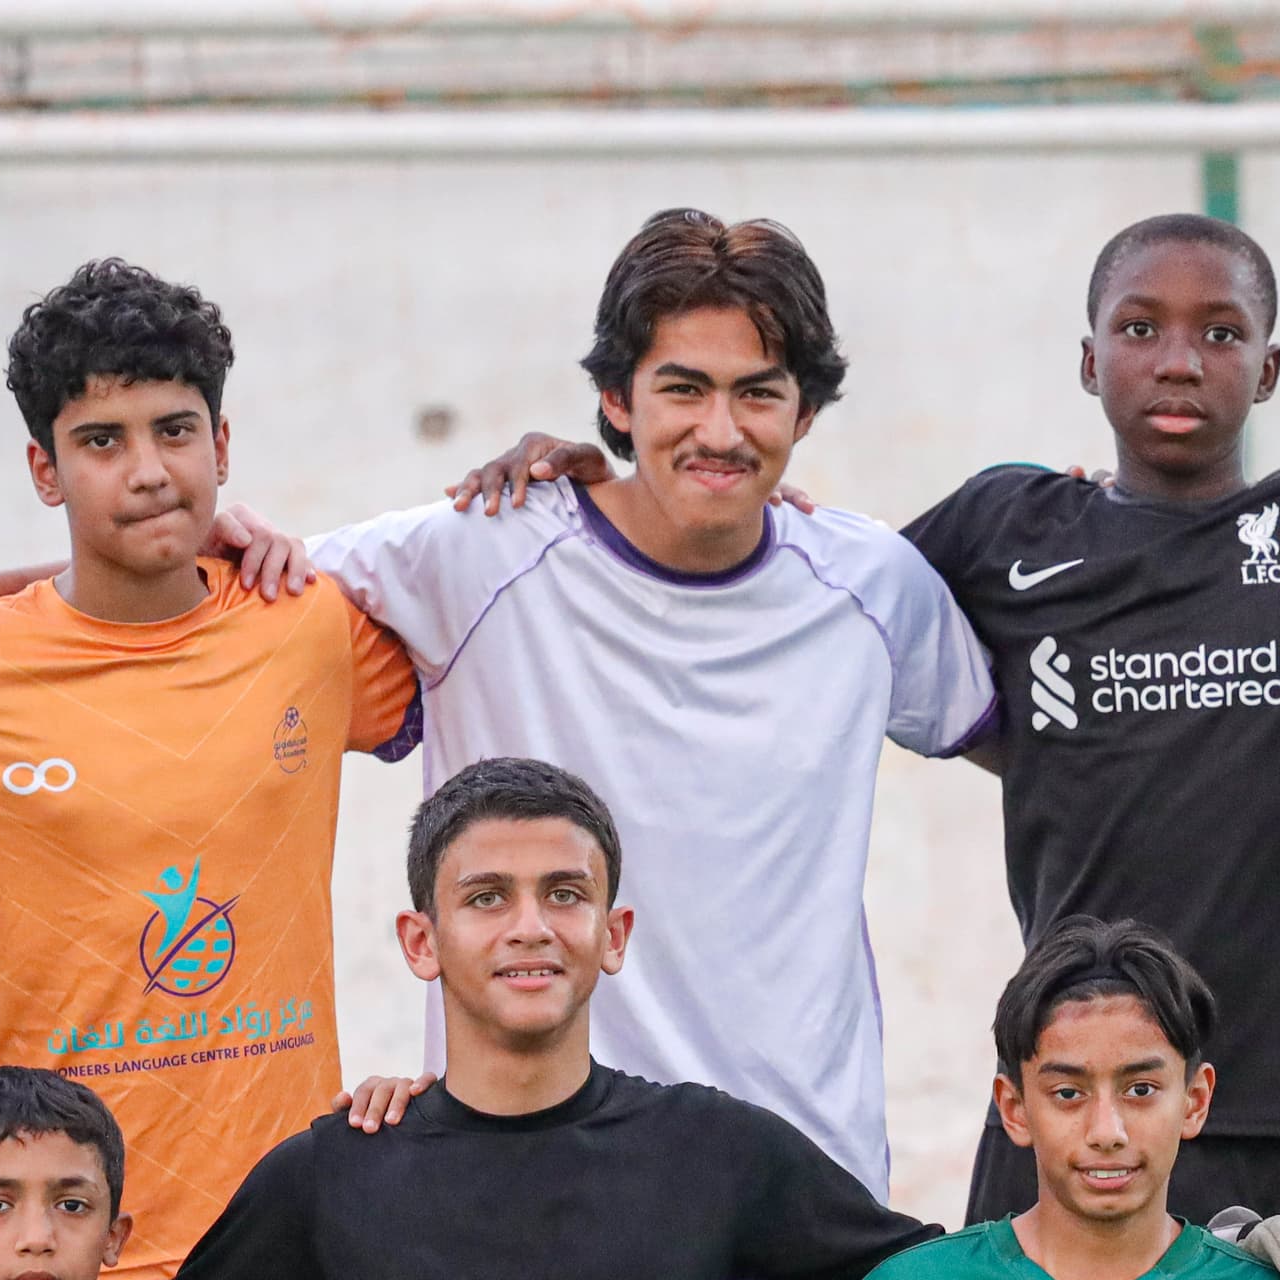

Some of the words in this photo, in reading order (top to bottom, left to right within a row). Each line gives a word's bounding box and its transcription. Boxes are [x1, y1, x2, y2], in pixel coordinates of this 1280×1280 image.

[1090, 640, 1277, 681] standard
[47, 1021, 125, 1055] للغات
[135, 1011, 208, 1045] اللغة
[54, 1063, 112, 1079] ONEERS
[114, 1054, 187, 1074] LANGUAGE
[191, 1047, 240, 1064] CENTRE
[243, 1042, 267, 1058] FOR
